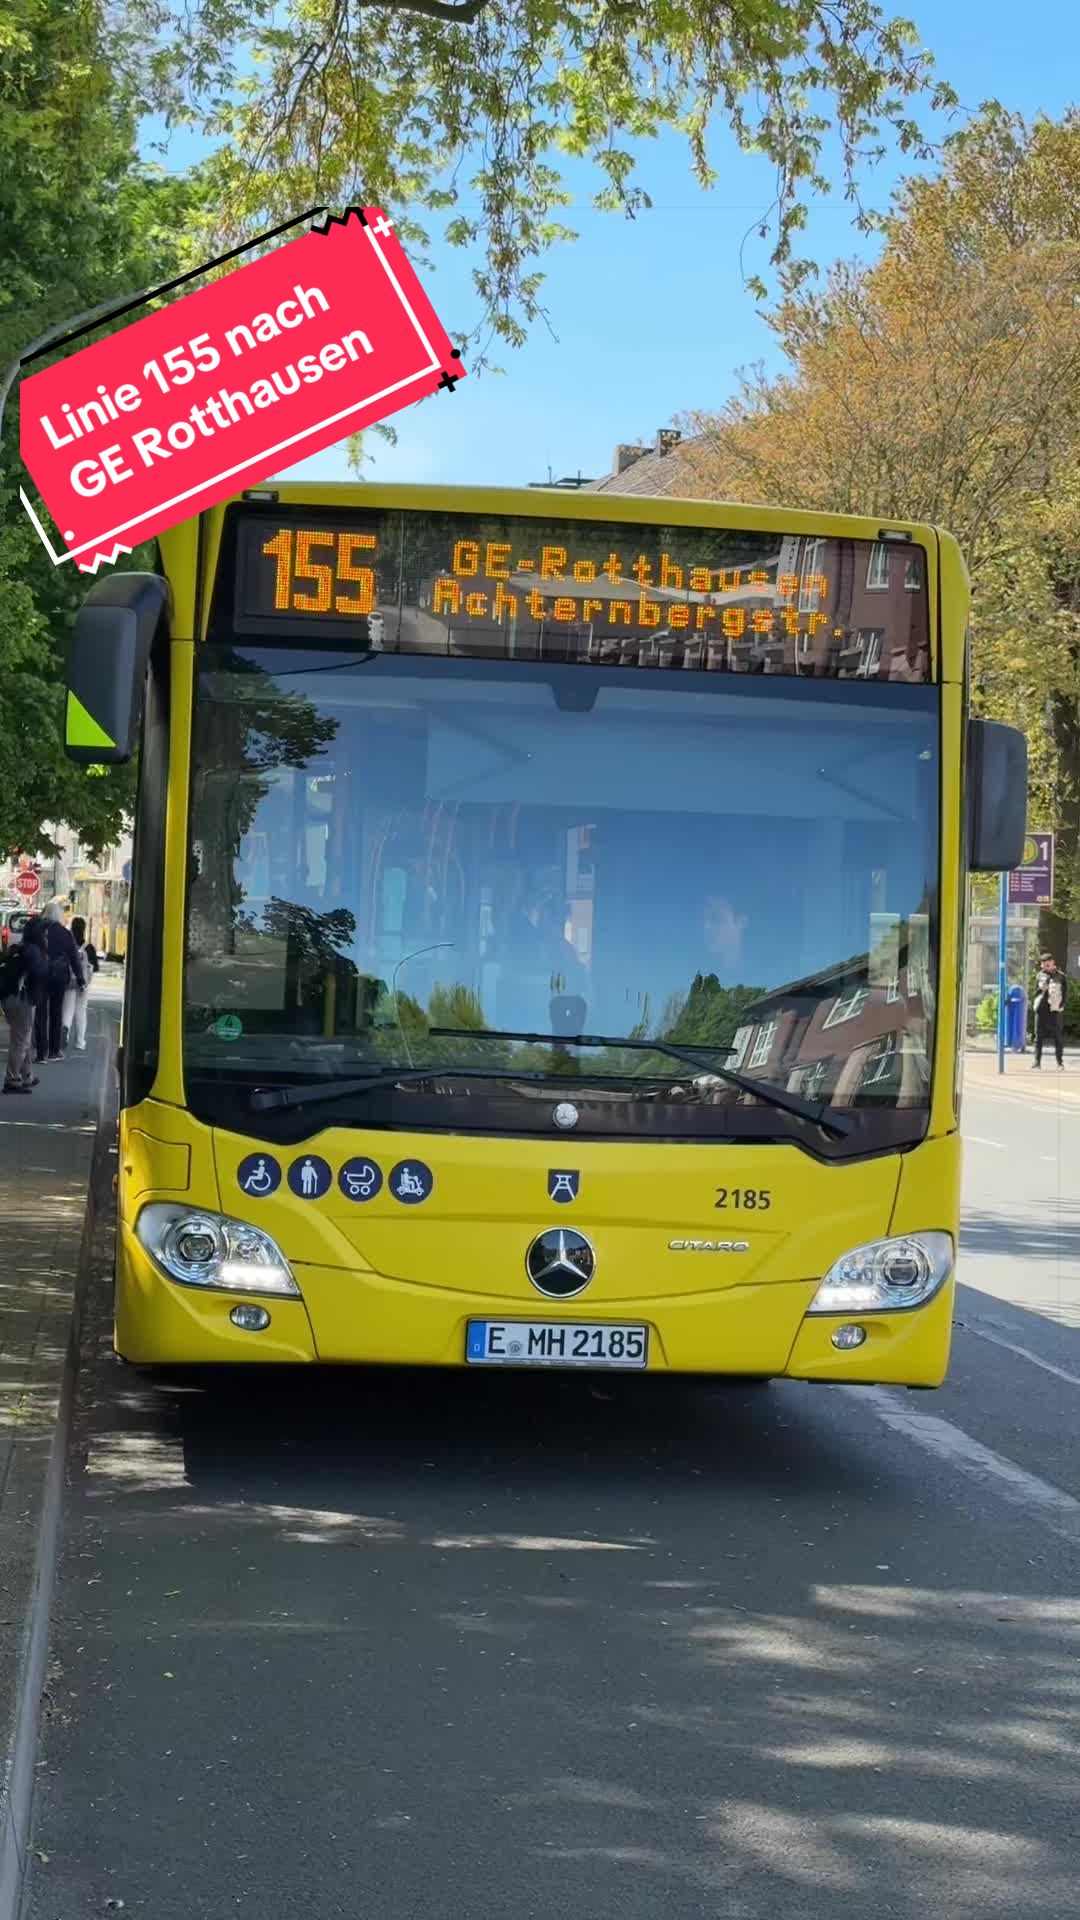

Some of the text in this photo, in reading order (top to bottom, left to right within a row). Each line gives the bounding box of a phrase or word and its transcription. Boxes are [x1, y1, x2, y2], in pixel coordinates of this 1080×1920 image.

[263, 529, 376, 614] 155
[453, 541, 828, 598] GE-Rotthausen
[433, 578, 844, 639] Achternbergstr.
[1040, 841, 1048, 861] 1
[17, 879, 38, 889] STOP
[714, 1188, 772, 1210] 2185
[667, 1239, 749, 1252] CITARO
[488, 1327, 506, 1354] E
